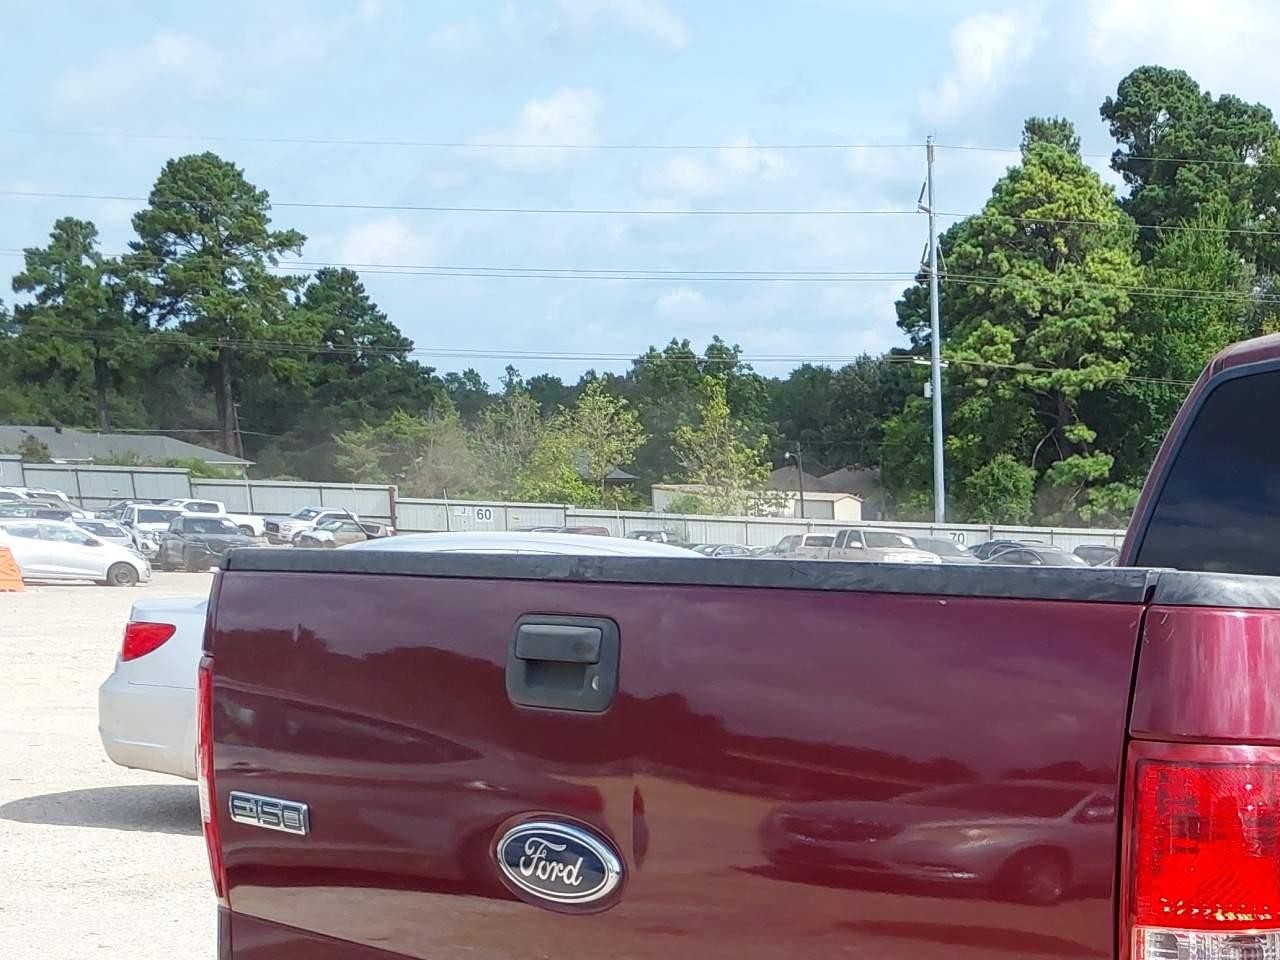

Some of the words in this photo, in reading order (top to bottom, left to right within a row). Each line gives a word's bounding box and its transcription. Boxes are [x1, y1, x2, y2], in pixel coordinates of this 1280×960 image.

[476, 508, 492, 521] 60
[949, 532, 965, 545] 70
[520, 837, 584, 886] Ford
